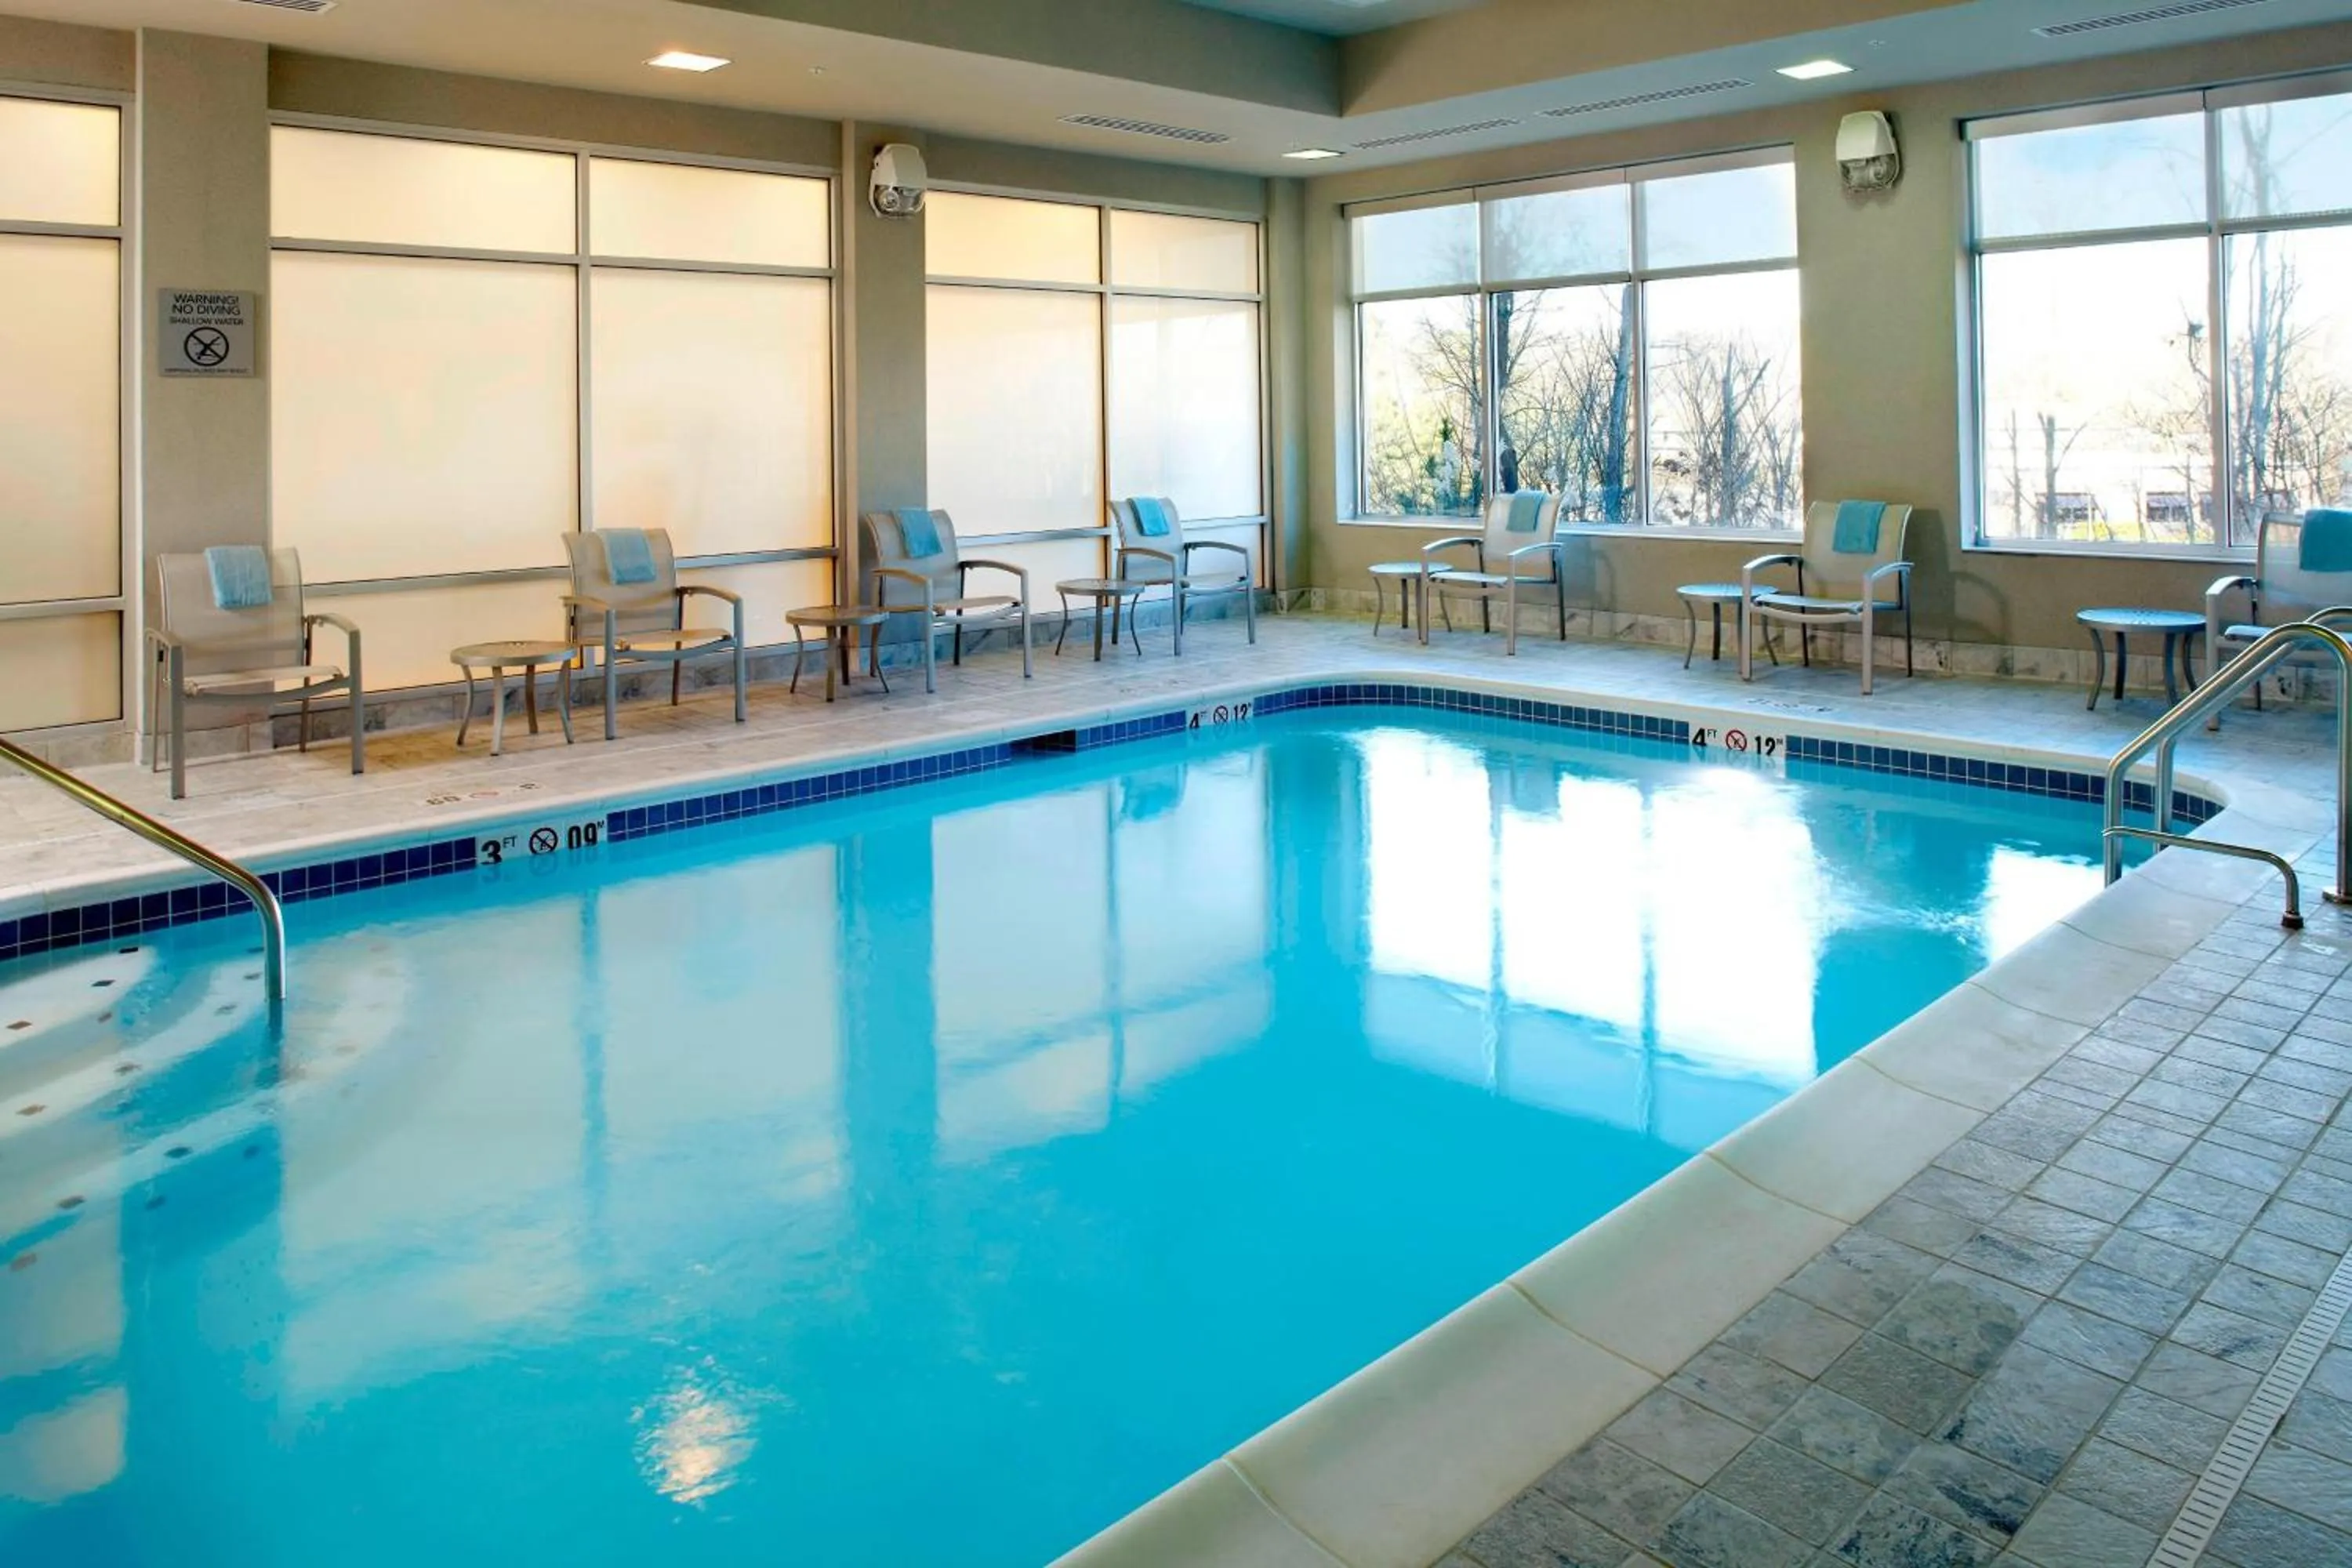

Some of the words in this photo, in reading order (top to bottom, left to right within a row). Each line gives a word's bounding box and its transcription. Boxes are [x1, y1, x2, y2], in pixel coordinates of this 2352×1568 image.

[173, 293, 239, 304] WARNING!
[172, 304, 194, 314] NO
[197, 304, 241, 315] DIVING
[169, 316, 212, 325] SHALLOW
[214, 317, 244, 325] WATER
